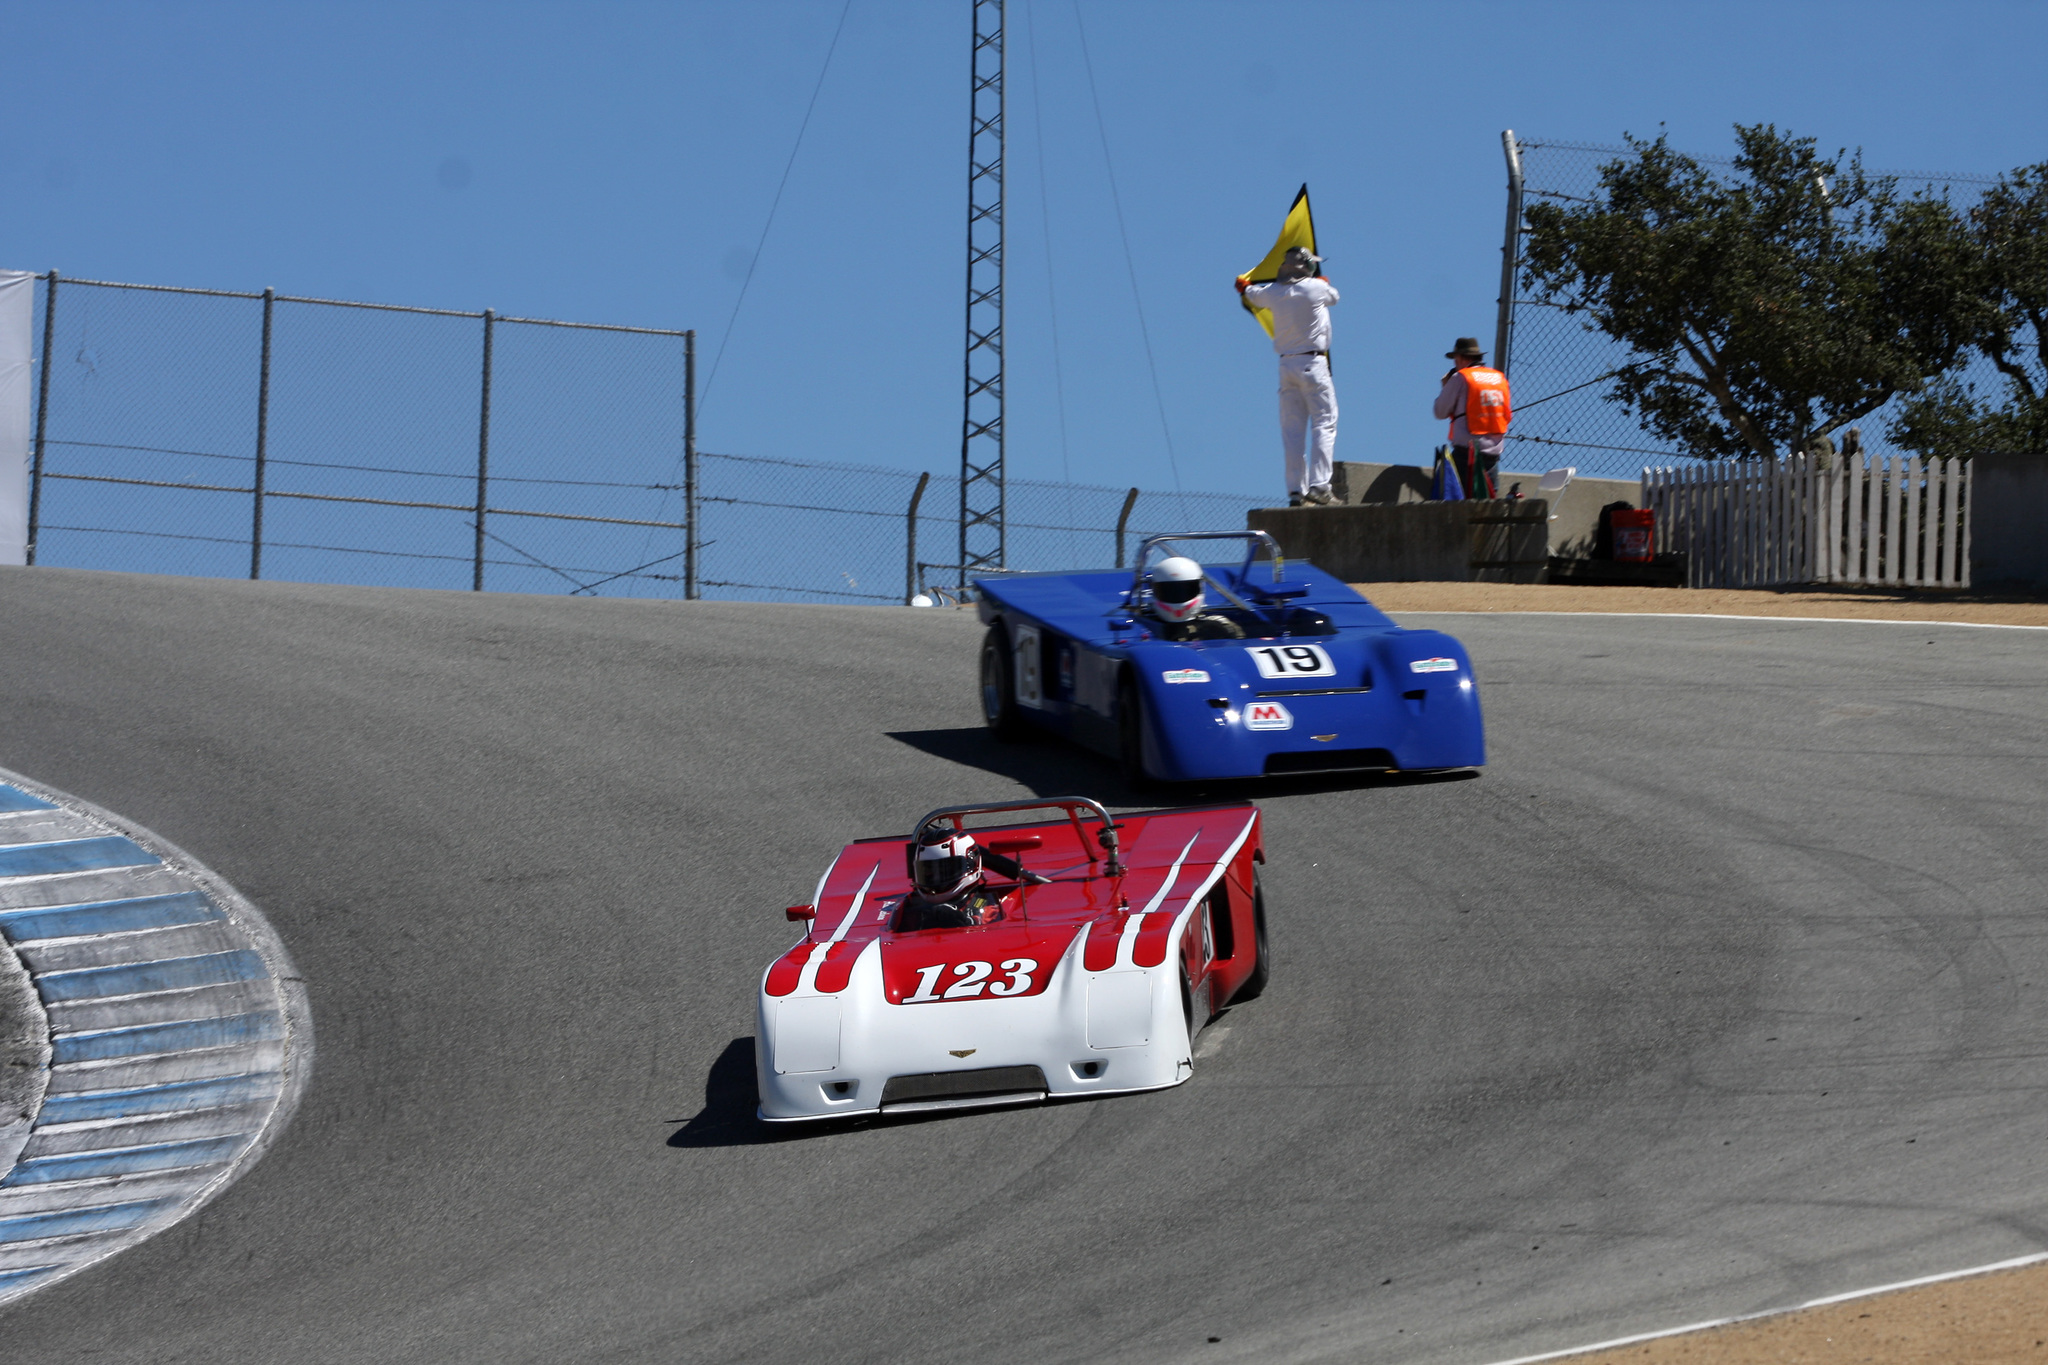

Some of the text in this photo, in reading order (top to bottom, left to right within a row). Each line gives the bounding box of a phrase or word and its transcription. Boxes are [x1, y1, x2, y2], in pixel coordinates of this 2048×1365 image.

[1257, 646, 1322, 672] 19
[1253, 706, 1281, 720] M
[901, 958, 1039, 1005] 123
